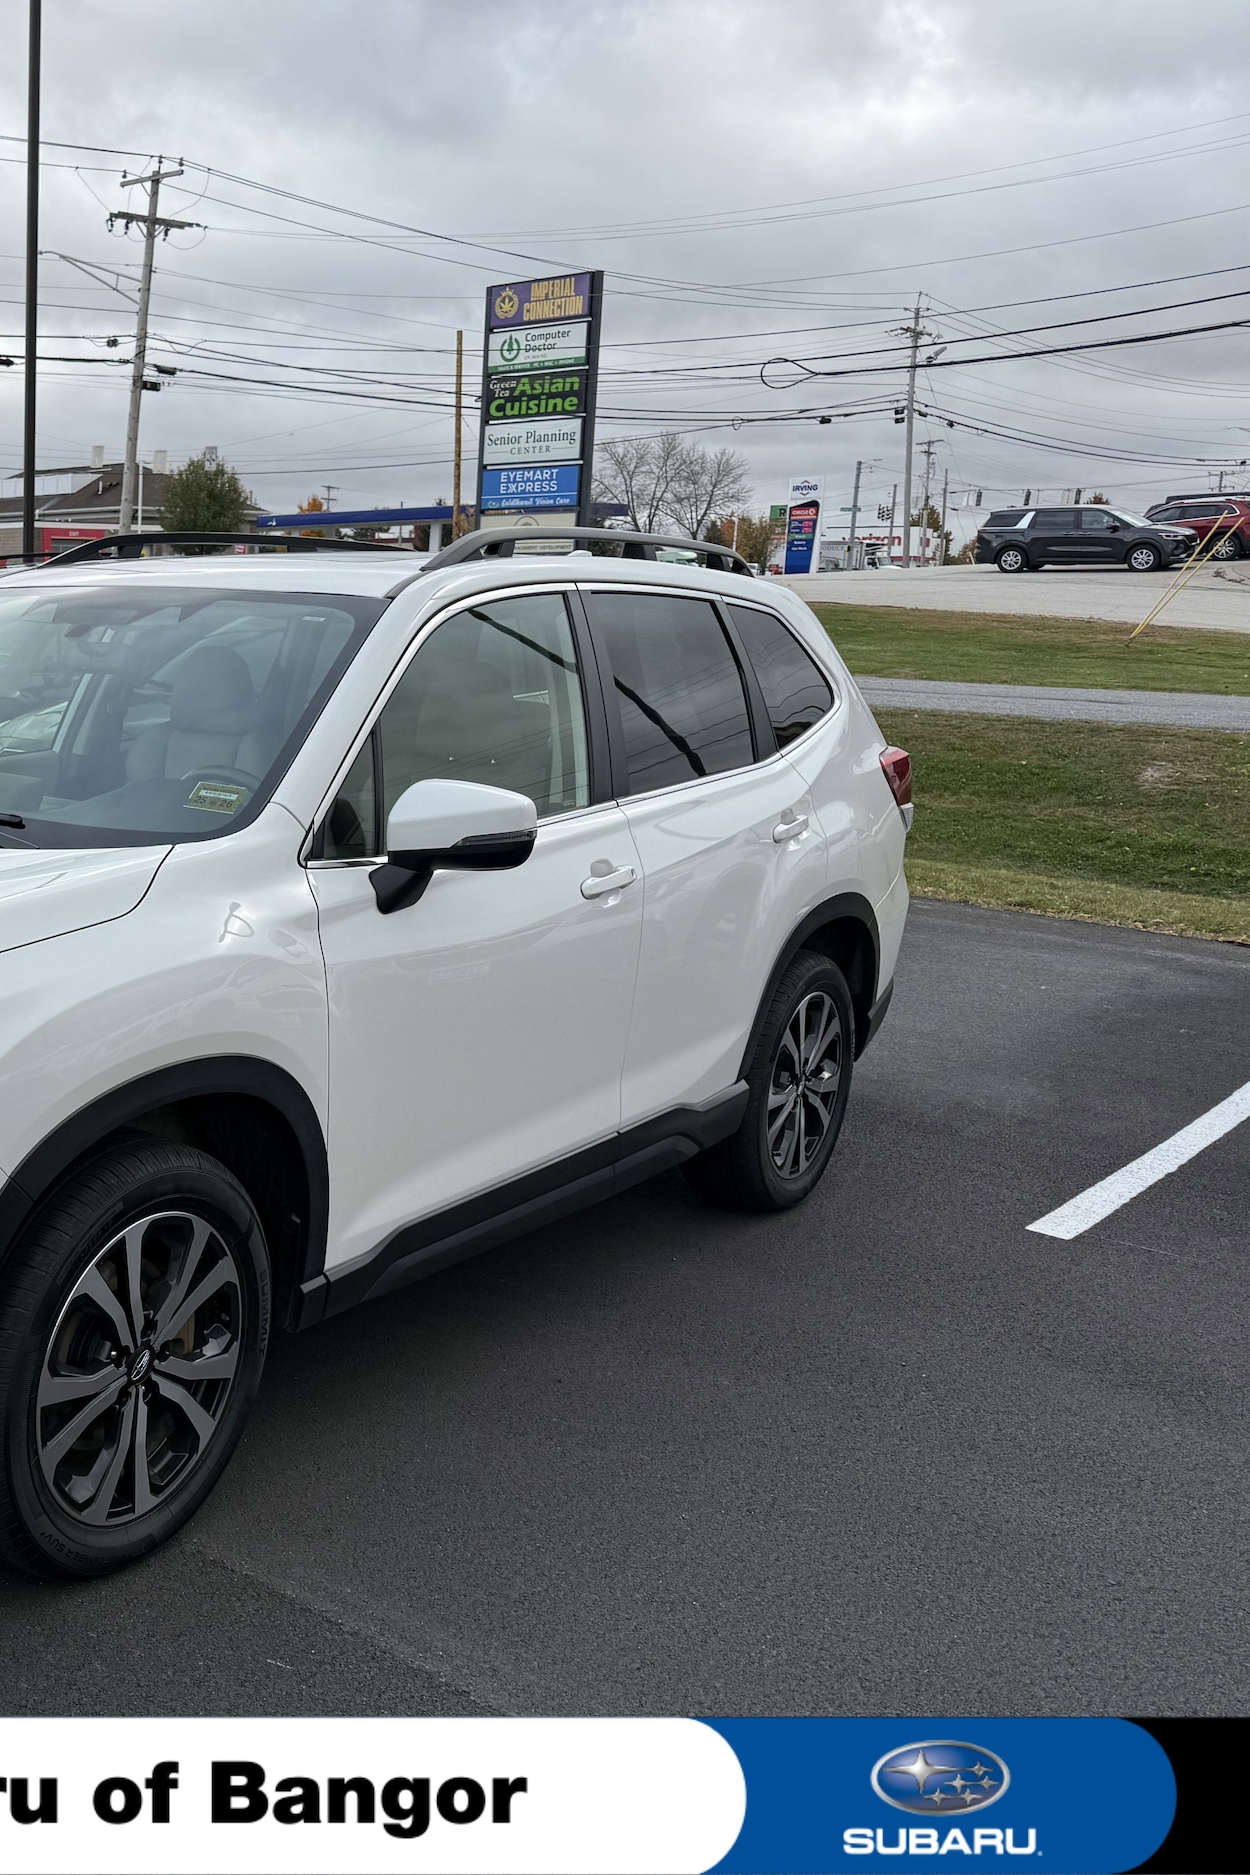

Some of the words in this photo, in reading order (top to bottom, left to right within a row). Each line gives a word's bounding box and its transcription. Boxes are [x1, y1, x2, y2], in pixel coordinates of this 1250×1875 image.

[530, 277, 576, 302] IMPERIAL
[523, 295, 584, 321] CONNECTION
[525, 329, 572, 342] Computer
[524, 342, 558, 353] Doctor
[489, 380, 517, 389] Green
[513, 376, 580, 397] Asian
[494, 388, 510, 398] Tea
[489, 396, 579, 417] Cuisine
[487, 433, 523, 446] Senior
[525, 429, 577, 445] Planning
[510, 445, 551, 455] CENTER
[500, 469, 559, 482] EYEMART
[500, 481, 558, 494] EXPRESS
[792, 484, 818, 492] IRVING
[193, 796, 208, 804] 25
[218, 799, 234, 808] 26
